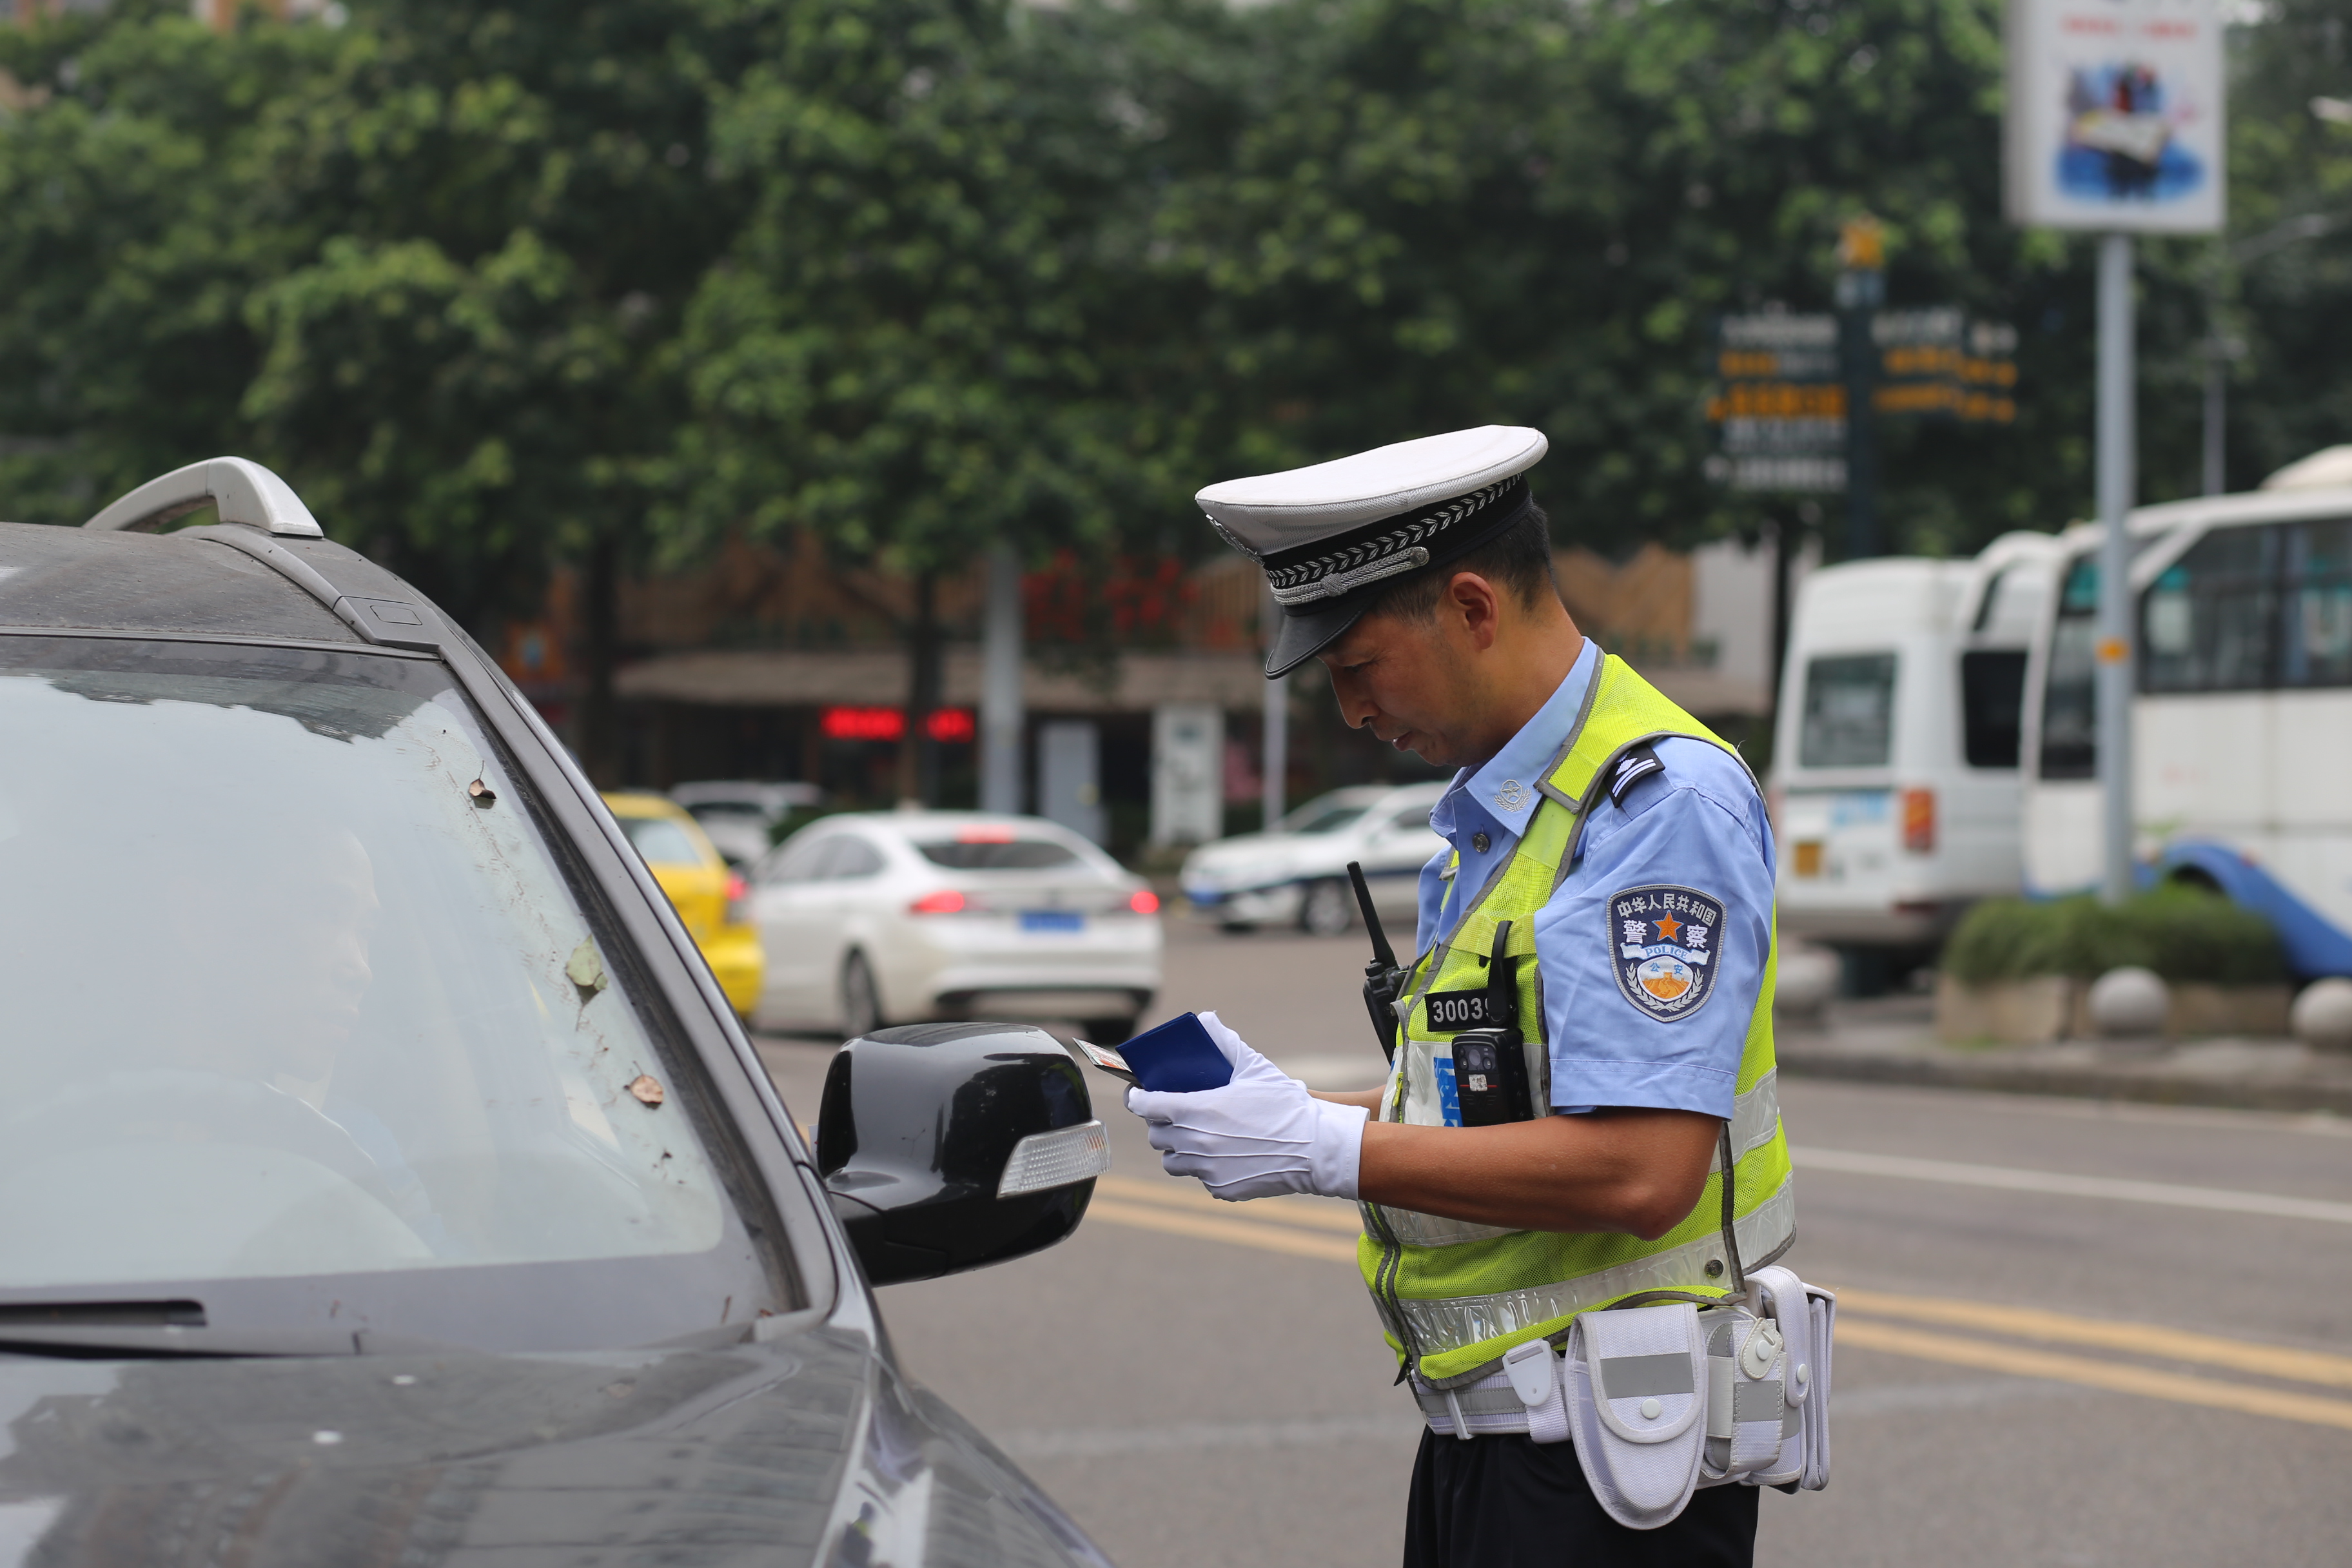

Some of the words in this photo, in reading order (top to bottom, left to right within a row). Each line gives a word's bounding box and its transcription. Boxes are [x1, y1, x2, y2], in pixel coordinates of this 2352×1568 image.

[1617, 893, 1717, 927] 中华人民共和国
[1645, 946, 1687, 960] POLICE
[1433, 997, 1488, 1023] 3003
